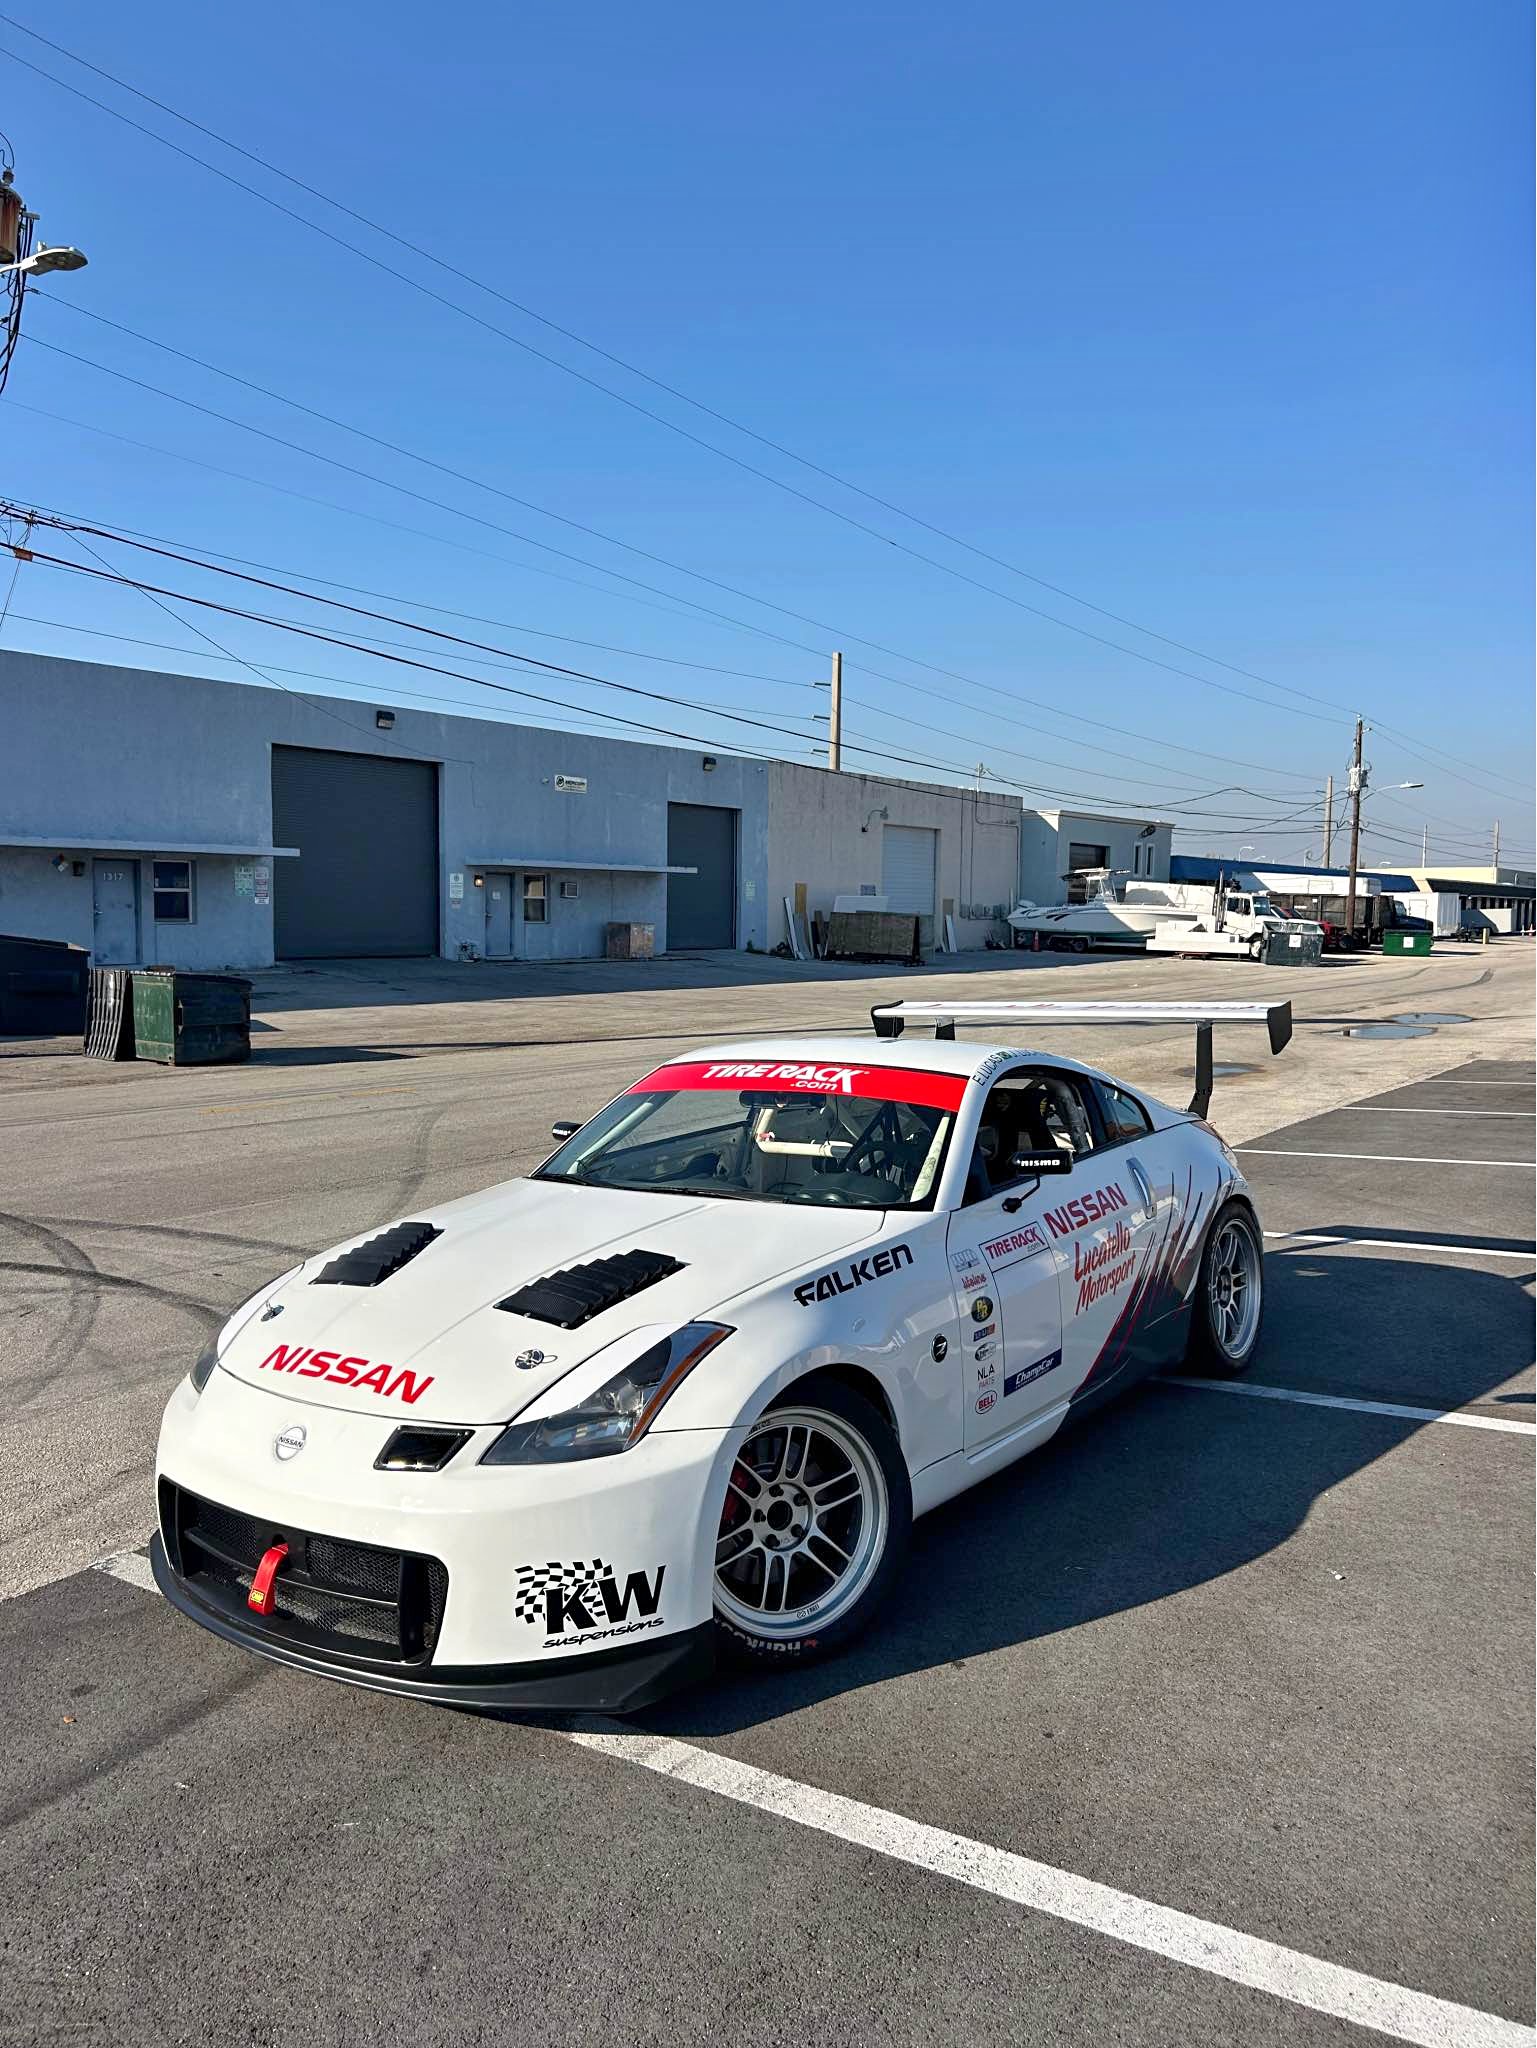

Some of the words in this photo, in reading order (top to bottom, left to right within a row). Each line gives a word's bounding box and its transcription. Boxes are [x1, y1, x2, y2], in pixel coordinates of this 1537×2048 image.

[790, 1080, 838, 1091] .com
[1043, 1182, 1128, 1239] NISSAN
[1075, 1221, 1131, 1282] Lucatello
[793, 1243, 914, 1307] FALKEN
[1075, 1250, 1137, 1315] Motorsport
[259, 1344, 435, 1404] NISSAN
[977, 1363, 995, 1381] NLA
[1016, 1358, 1054, 1385] ChampCar
[979, 1394, 995, 1410] BELL
[278, 1436, 304, 1449] NISSAN
[545, 1564, 667, 1635] KW
[542, 1616, 665, 1649] suspensions
